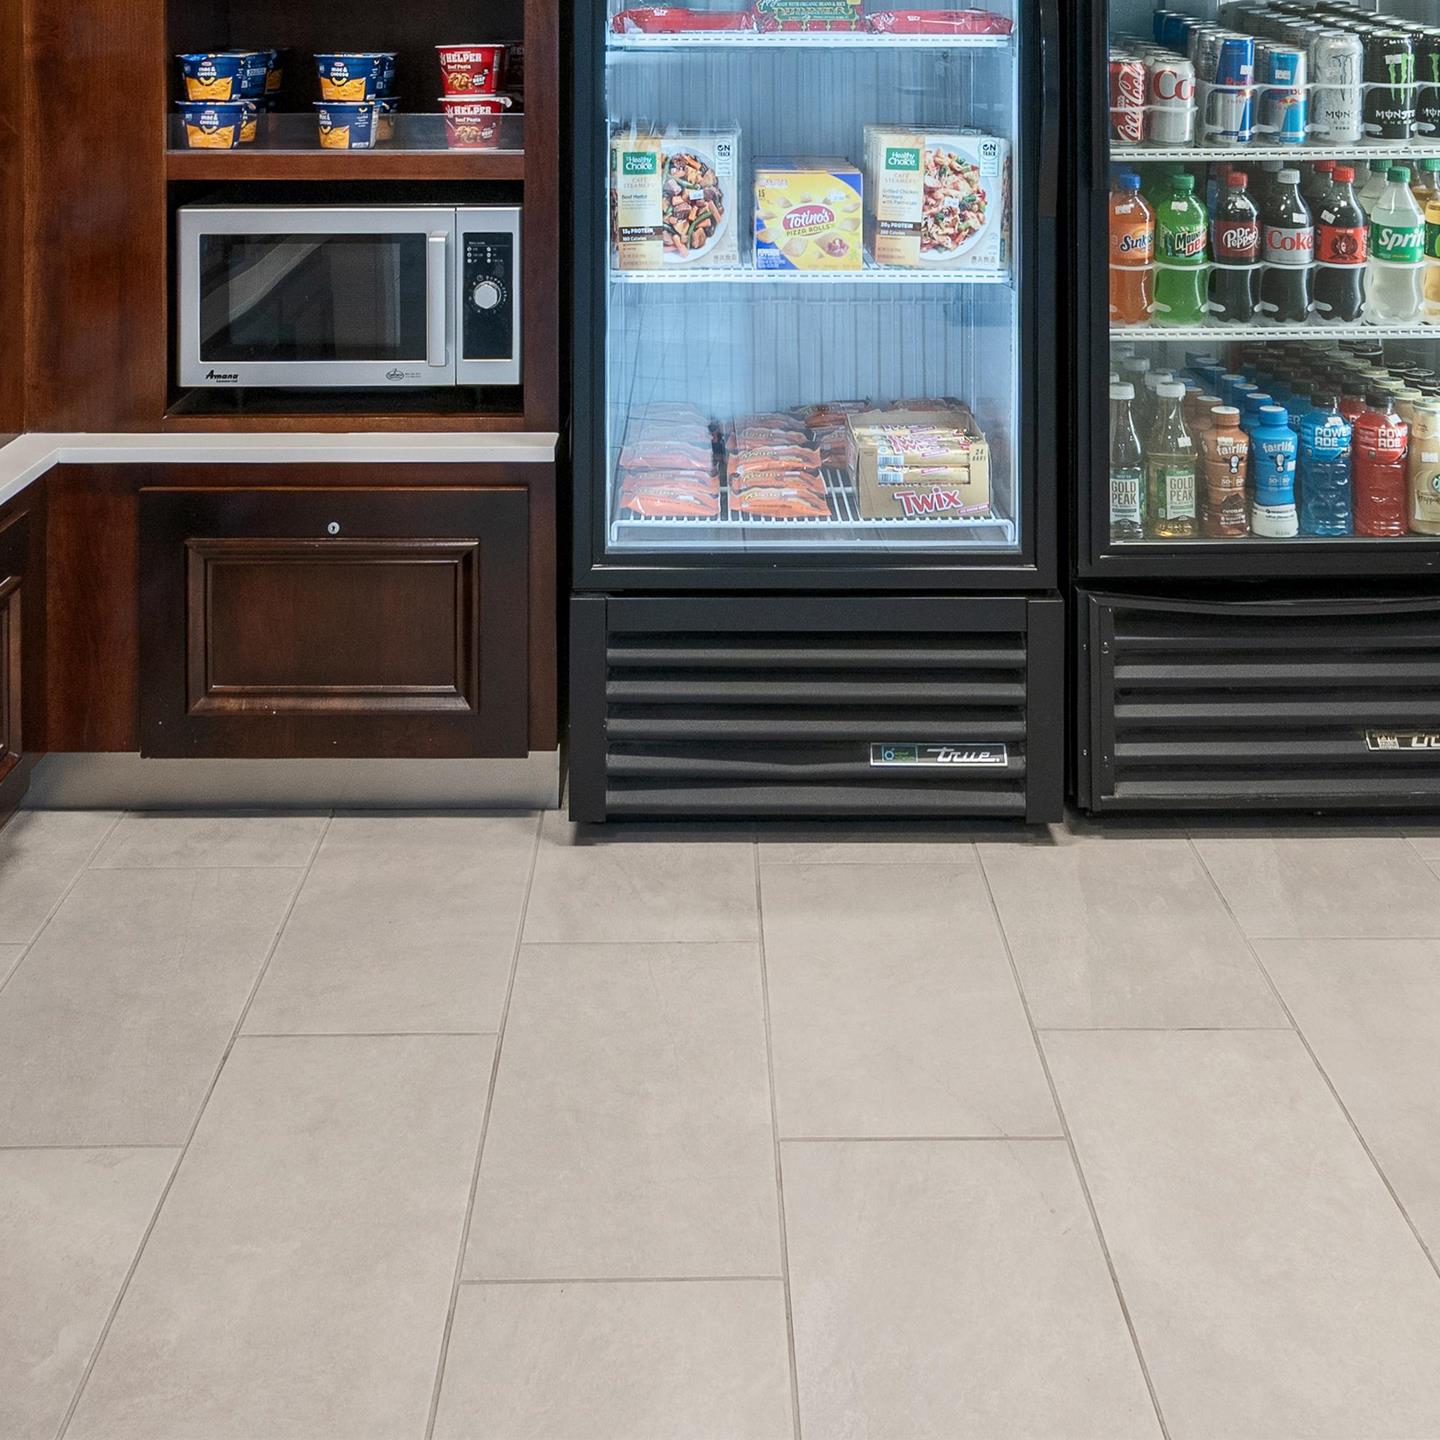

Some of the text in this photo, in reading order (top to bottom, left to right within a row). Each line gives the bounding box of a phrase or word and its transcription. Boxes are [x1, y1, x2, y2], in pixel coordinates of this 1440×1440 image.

[446, 53, 482, 63] HELPER
[454, 106, 492, 115] HELPER
[982, 144, 997, 152] ON
[629, 155, 652, 163] Healthy
[892, 151, 916, 160] Healthy
[625, 161, 653, 170] Choice
[888, 157, 916, 166] Choice
[786, 209, 831, 228] Totino's
[786, 224, 831, 237] PIZZA ROLLS
[1236, 227, 1252, 238] Dr
[1223, 230, 1258, 250] Pepper
[1266, 229, 1313, 251] Coke
[206, 368, 239, 381] Amana
[1262, 441, 1295, 454] fairlife
[1314, 437, 1338, 448] ADE
[1378, 437, 1402, 448] ADE
[1217, 442, 1249, 456] fairlife
[1111, 481, 1137, 492] GOLD
[1170, 477, 1193, 490] GOLD
[1111, 492, 1137, 505] PEAK
[1170, 490, 1193, 501] PEAK
[894, 487, 964, 517] Twix
[926, 747, 1001, 764] true
